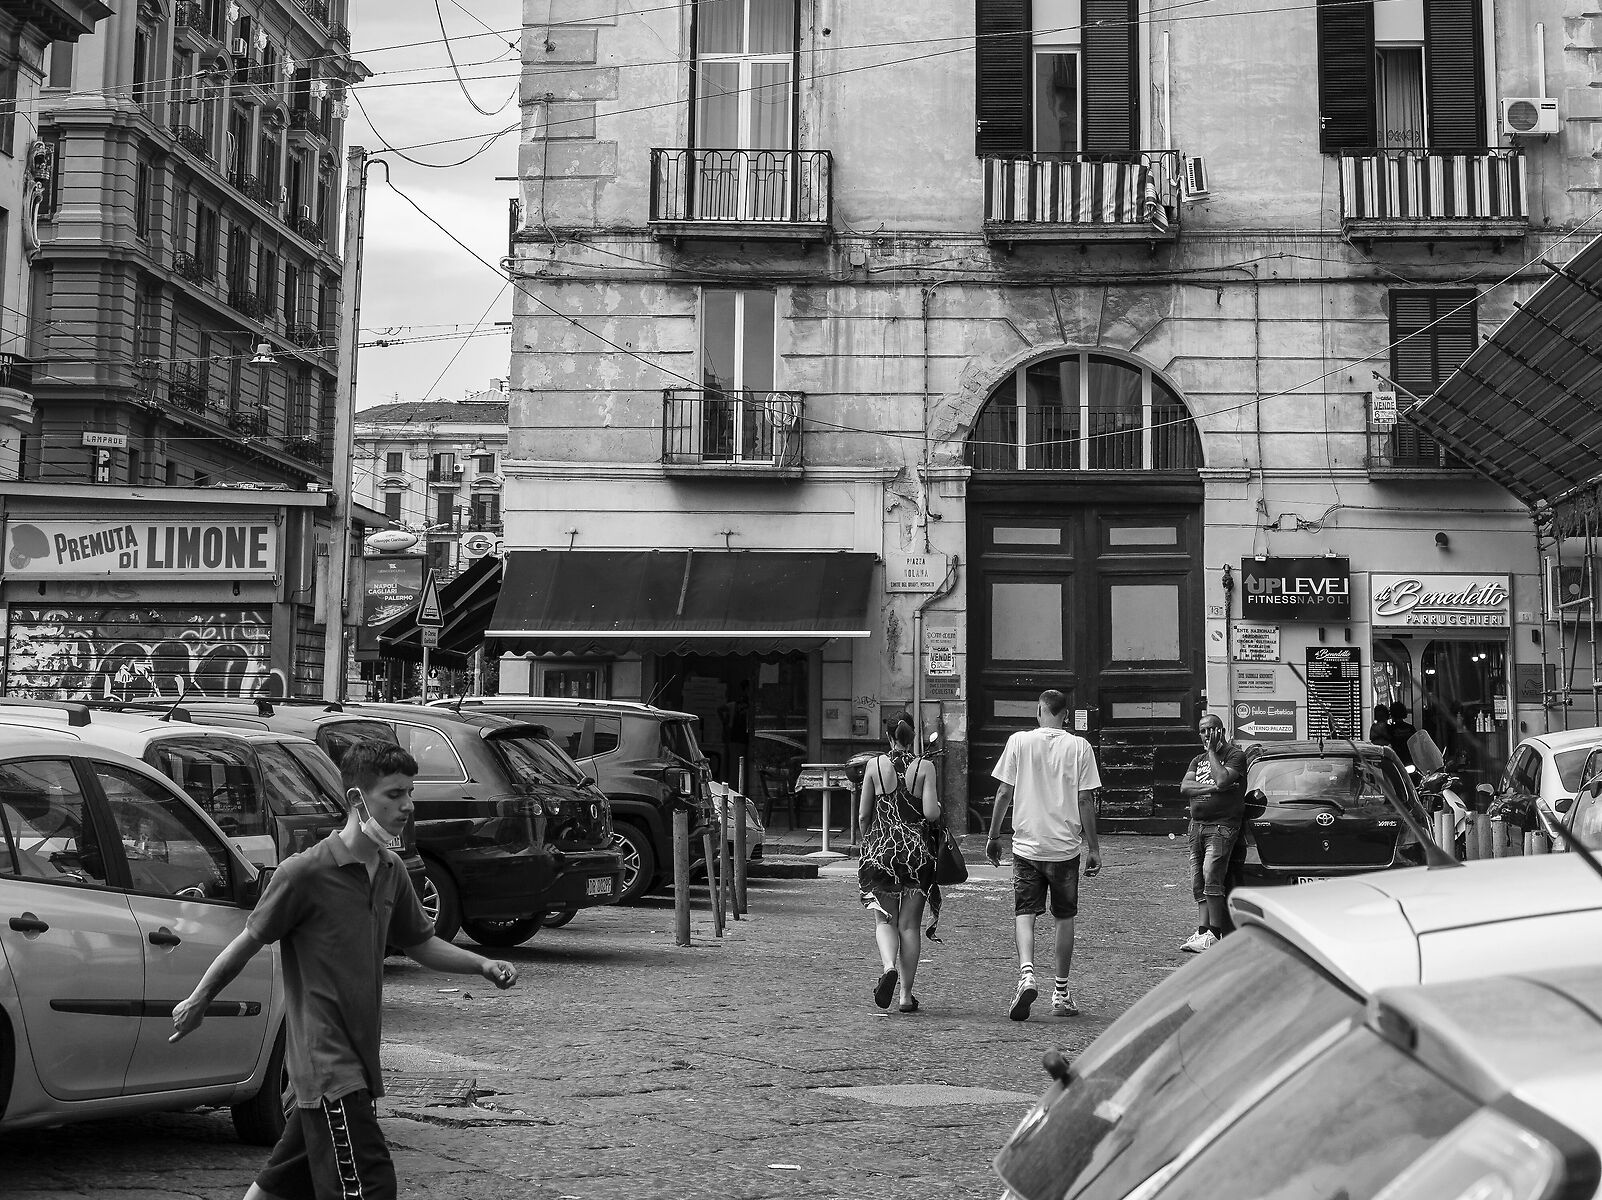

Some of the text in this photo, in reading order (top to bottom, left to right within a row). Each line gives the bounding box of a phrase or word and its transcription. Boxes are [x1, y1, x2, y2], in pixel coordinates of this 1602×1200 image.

[1374, 402, 1394, 410] VENDE
[54, 524, 139, 565] PREMUTA
[146, 526, 268, 569] LIMONE
[119, 549, 138, 569] DI
[1375, 578, 1509, 616] Benedetto
[1406, 614, 1504, 626] PARRUCCHIERI
[930, 653, 951, 661] VENDE
